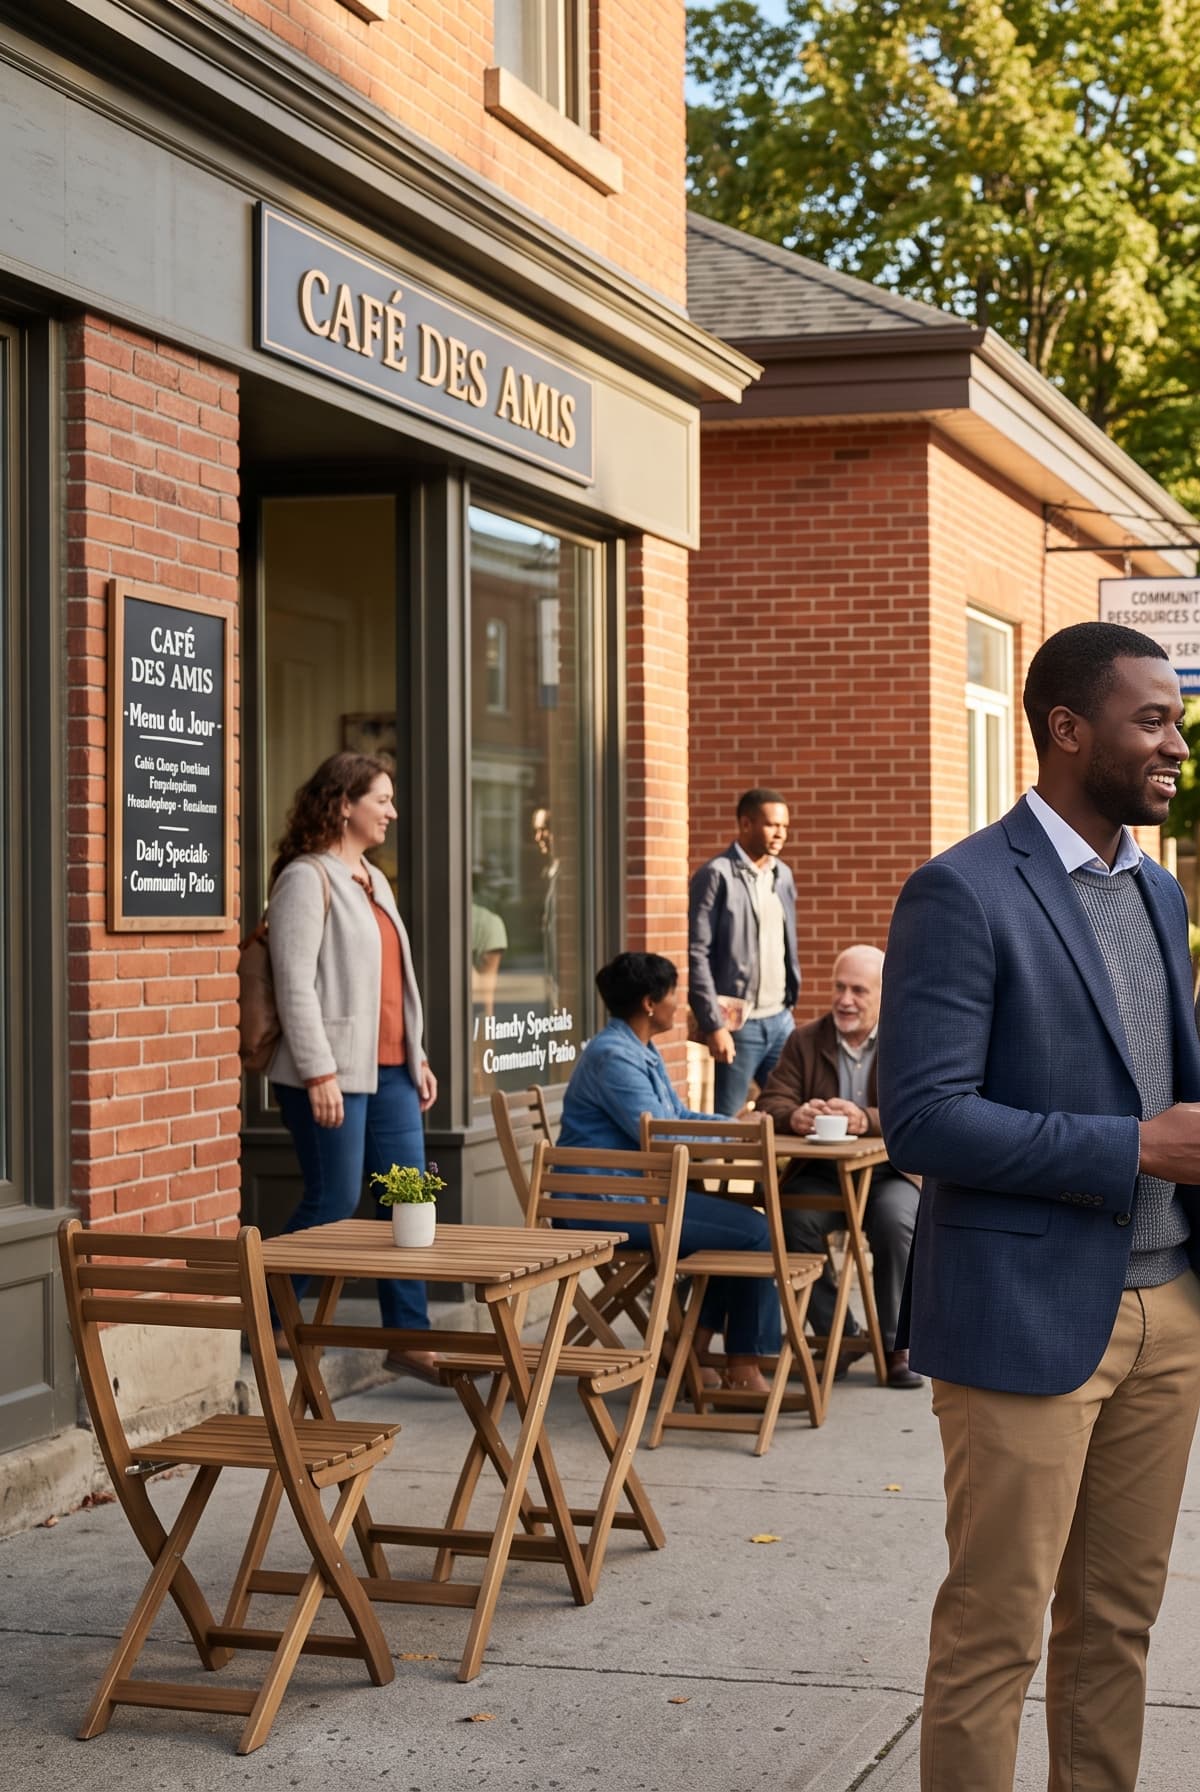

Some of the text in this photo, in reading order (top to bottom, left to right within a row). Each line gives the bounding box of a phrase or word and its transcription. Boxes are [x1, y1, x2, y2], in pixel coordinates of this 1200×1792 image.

[299, 269, 577, 449] CAFÉ DES AMIS
[150, 626, 196, 659] CAFÉ
[131, 656, 213, 694] DES AMIS
[168, 708, 184, 733] du
[136, 838, 208, 869] Daily Specials
[130, 869, 215, 898] Community Patio
[484, 1013, 526, 1043] Handy
[526, 1007, 573, 1040] Specials
[483, 1043, 547, 1074] Community
[548, 1039, 576, 1064] Patio
